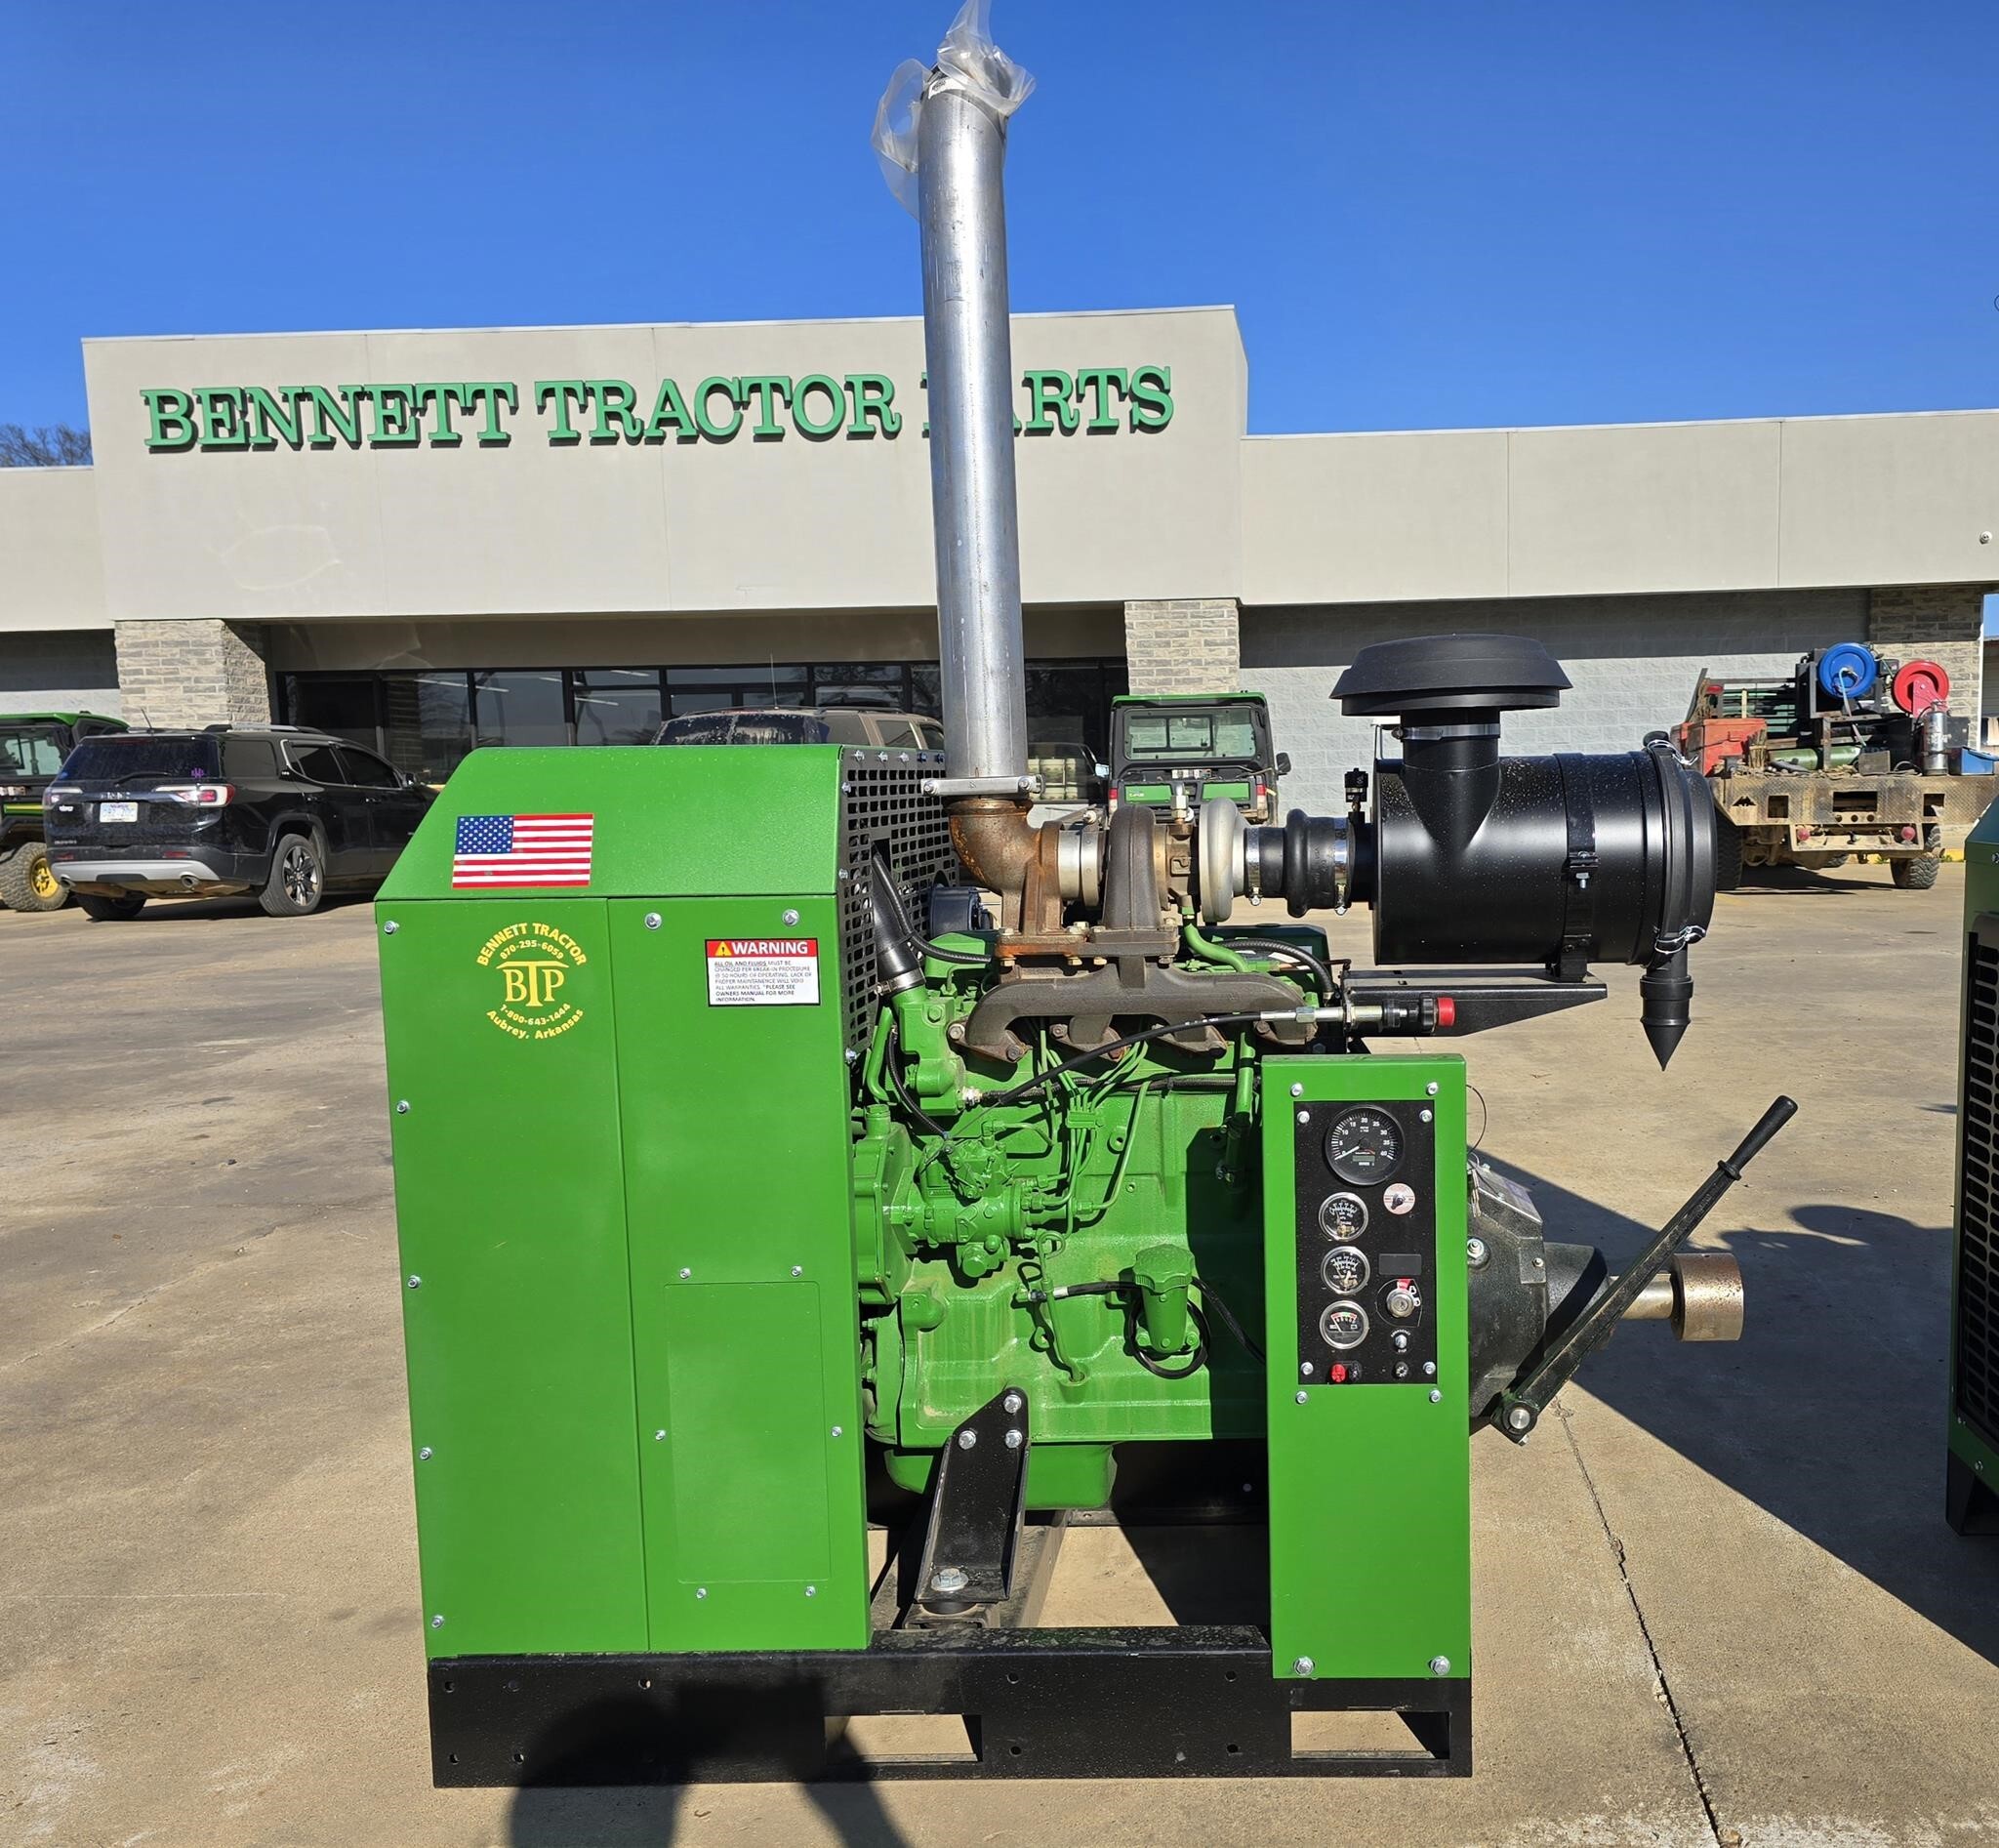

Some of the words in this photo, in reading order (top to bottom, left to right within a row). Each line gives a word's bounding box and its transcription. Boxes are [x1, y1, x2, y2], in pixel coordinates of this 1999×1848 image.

[140, 381, 517, 450] BENNETT
[535, 373, 902, 445] TRACTOR
[921, 366, 1173, 436] RTS
[476, 923, 528, 966] BENNETT
[532, 923, 587, 965] TRACTOR
[731, 941, 808, 955] WARNING
[496, 961, 570, 1006] BTP
[486, 1010, 530, 1040] Aubrey,
[534, 1008, 584, 1040] Arkansas
[500, 1004, 571, 1025] 1-800-643-1444
